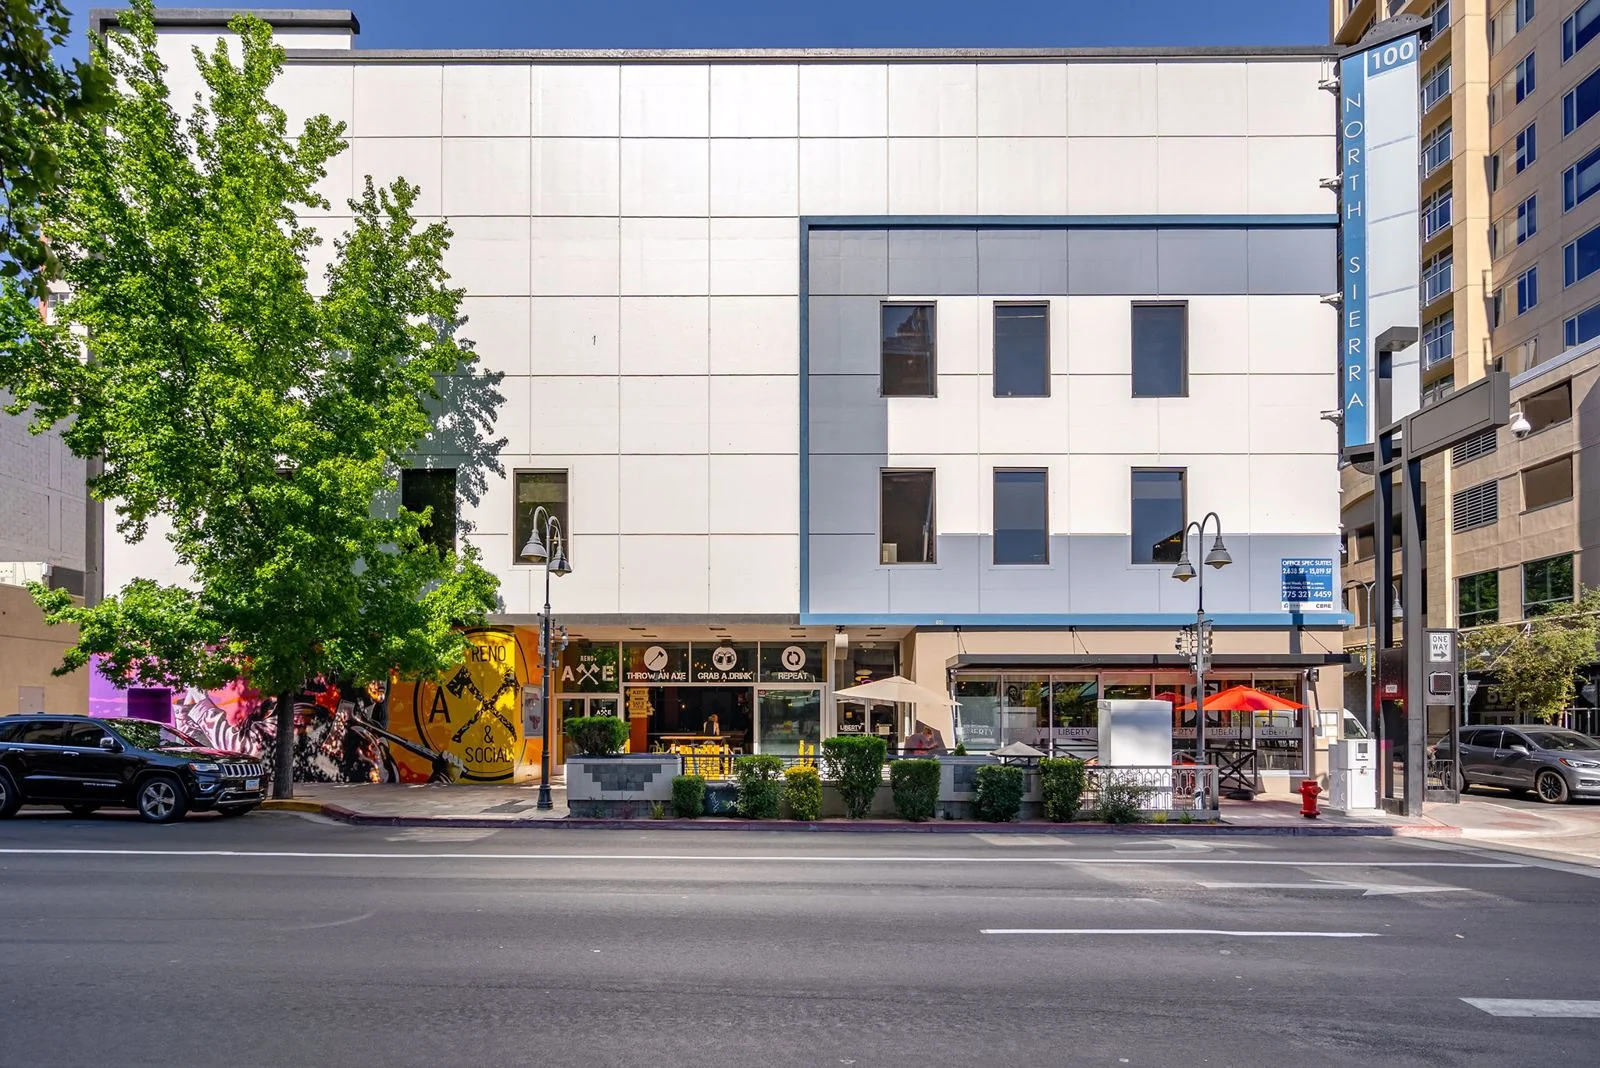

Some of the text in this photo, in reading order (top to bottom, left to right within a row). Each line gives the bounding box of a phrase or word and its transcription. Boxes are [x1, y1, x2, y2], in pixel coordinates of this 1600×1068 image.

[1372, 42, 1414, 70] 100
[1344, 93, 1364, 409] NORTH SIERRA
[1282, 590, 1332, 598] 775 321 4459
[1432, 635, 1448, 643] ONE
[1432, 643, 1449, 651] WAY
[471, 645, 506, 662] RENO
[626, 672, 687, 680] THROW AN AXE
[697, 672, 752, 680] GRAB A DRINK
[778, 672, 808, 680] REPEAT
[840, 723, 863, 732] LIBERTY
[484, 725, 494, 744] &
